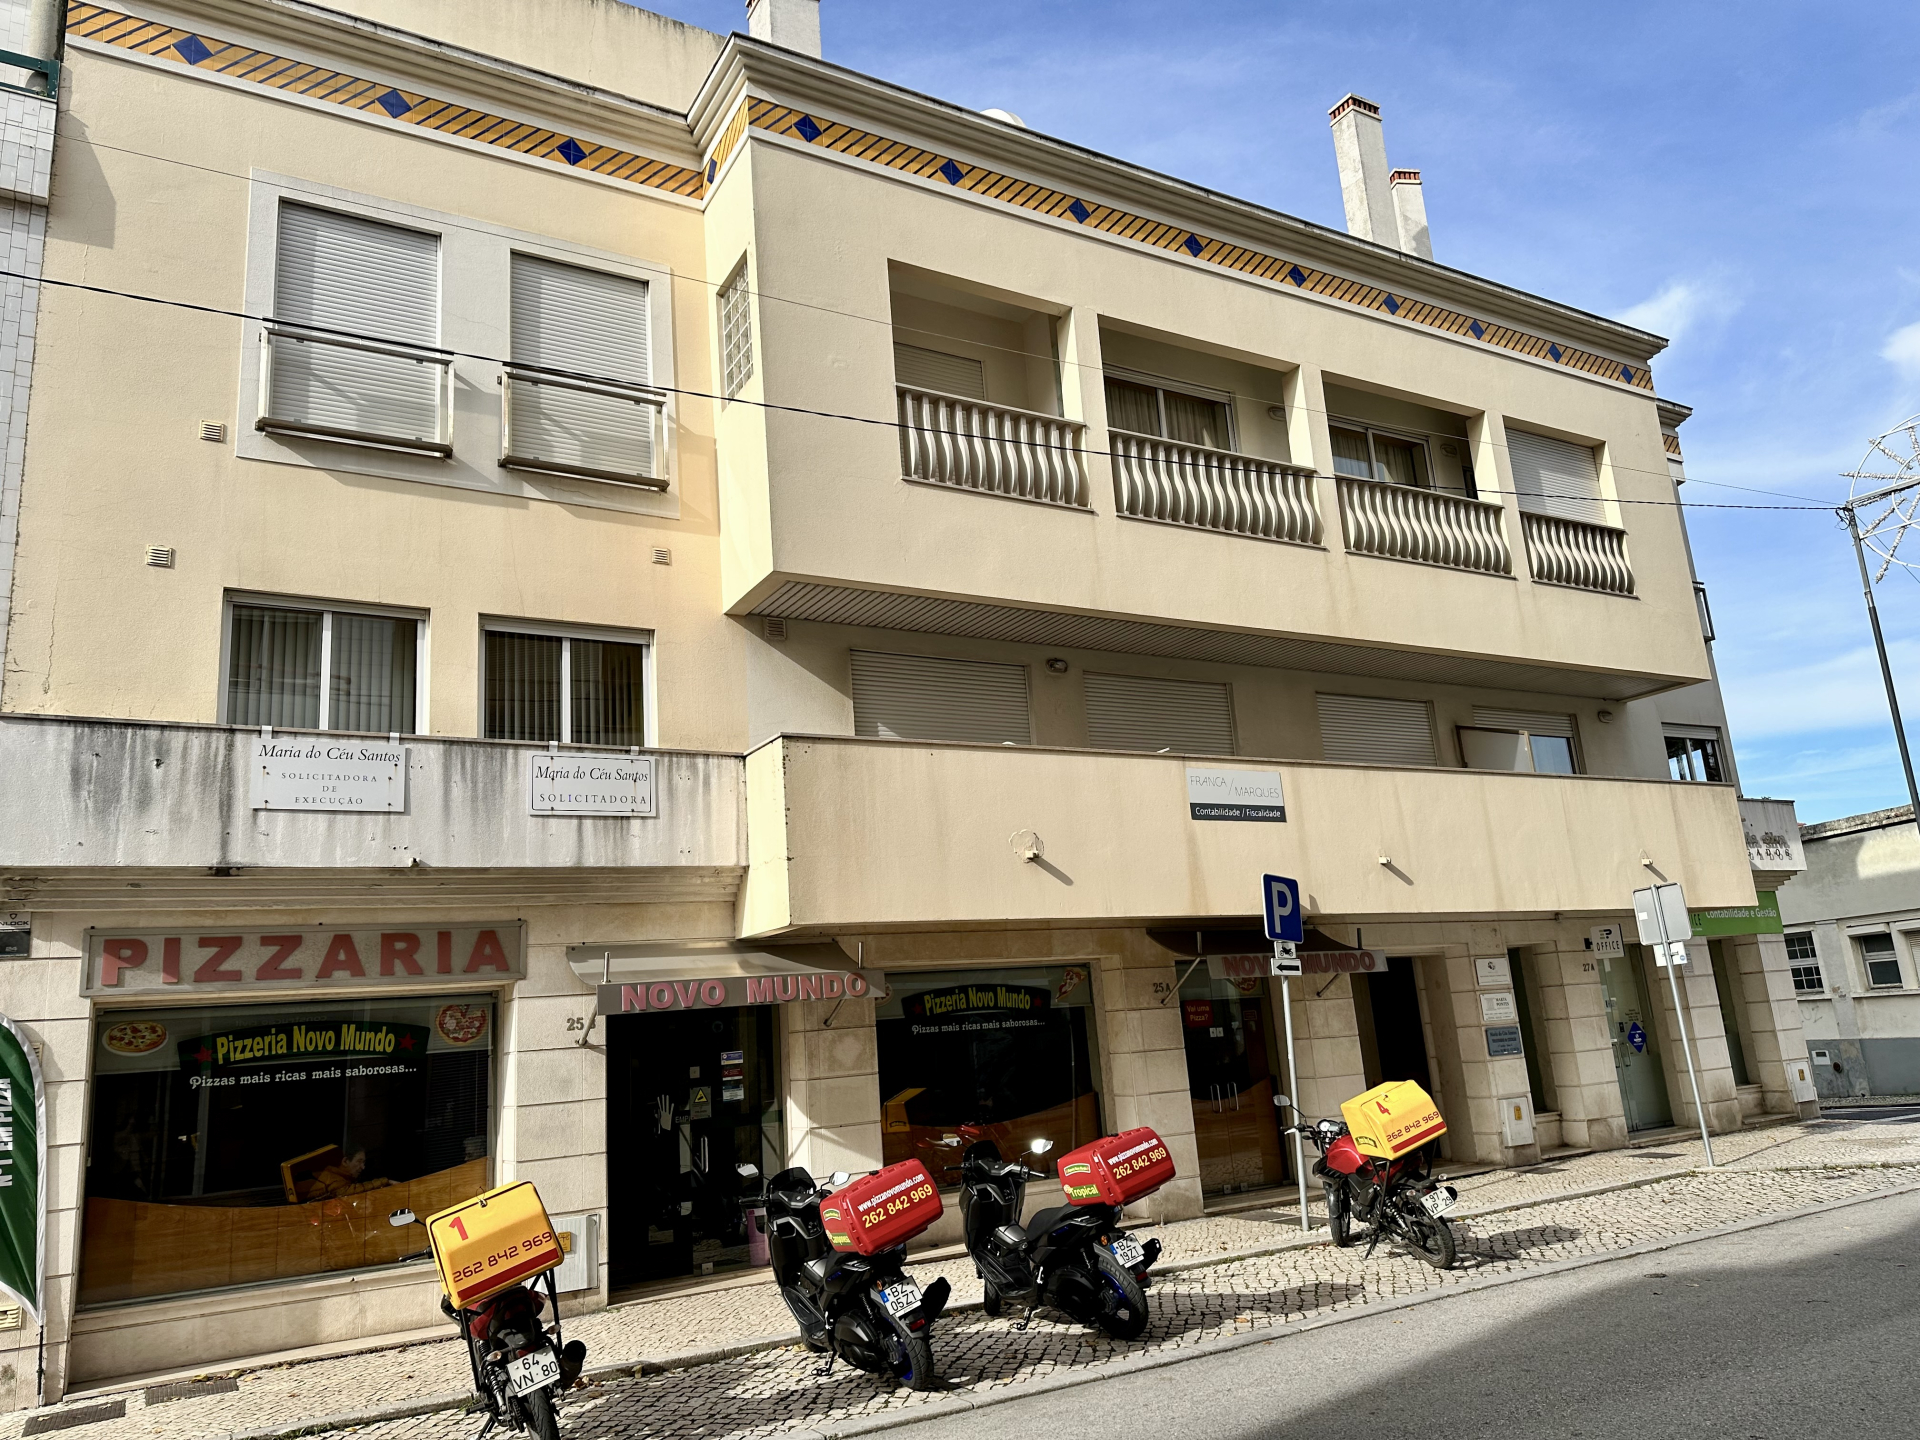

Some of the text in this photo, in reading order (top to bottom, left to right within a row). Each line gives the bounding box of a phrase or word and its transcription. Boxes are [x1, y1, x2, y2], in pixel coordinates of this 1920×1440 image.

[258, 744, 401, 763] Maria do Céu Santos
[281, 772, 377, 782] SOLICITADORA
[535, 765, 648, 782] Maria do Céu Santos
[295, 796, 363, 805] EXECUÇÃO
[539, 793, 647, 804] SOLICITADORA
[1234, 786, 1280, 798] MARQUES
[1195, 806, 1240, 817] Contabilidade
[1246, 808, 1281, 818] Fiscalidade
[1271, 881, 1293, 934] P
[1706, 909, 1750, 918] Contabilidade
[1755, 908, 1777, 917] Gestão
[1690, 913, 1702, 926] ICE
[1596, 940, 1620, 951] OFFICE
[101, 929, 510, 986] PIZZARIA
[1221, 952, 1376, 977] NOV MUNDO
[621, 973, 867, 1012] NOVO MUNDO
[923, 986, 1031, 1016] Pizzeria Novo Mundo
[1189, 1013, 1209, 1021] Pizza?
[912, 1018, 1045, 1035] Pizzas mais ricas mais saborosas...
[216, 1024, 395, 1064] Pizzeria Novo Mundo
[189, 1064, 417, 1089] Pizzas mais ricas mais saborosas...
[0, 1078, 12, 1122] PIZZA
[1375, 1101, 1391, 1115] 4
[1386, 1129, 1403, 1142] 262
[1404, 1120, 1422, 1134] 842
[1422, 1111, 1440, 1125] 969
[1107, 1138, 1159, 1166] www.pizzanovomundo.com
[1113, 1147, 1167, 1179] 262 842 969
[857, 1173, 925, 1212] www.pizzanovomundo.com
[1070, 1184, 1099, 1198] Tropical
[1429, 1192, 1440, 1203] 97
[862, 1184, 933, 1228] 262 842 969
[448, 1216, 469, 1241] 1
[1117, 1239, 1131, 1251] BZ
[453, 1261, 484, 1283] 262
[488, 1245, 519, 1267] 842
[522, 1231, 553, 1252] 969
[890, 1282, 907, 1298] BZ
[891, 1290, 917, 1311] 05ZT
[521, 1354, 540, 1371] 64
